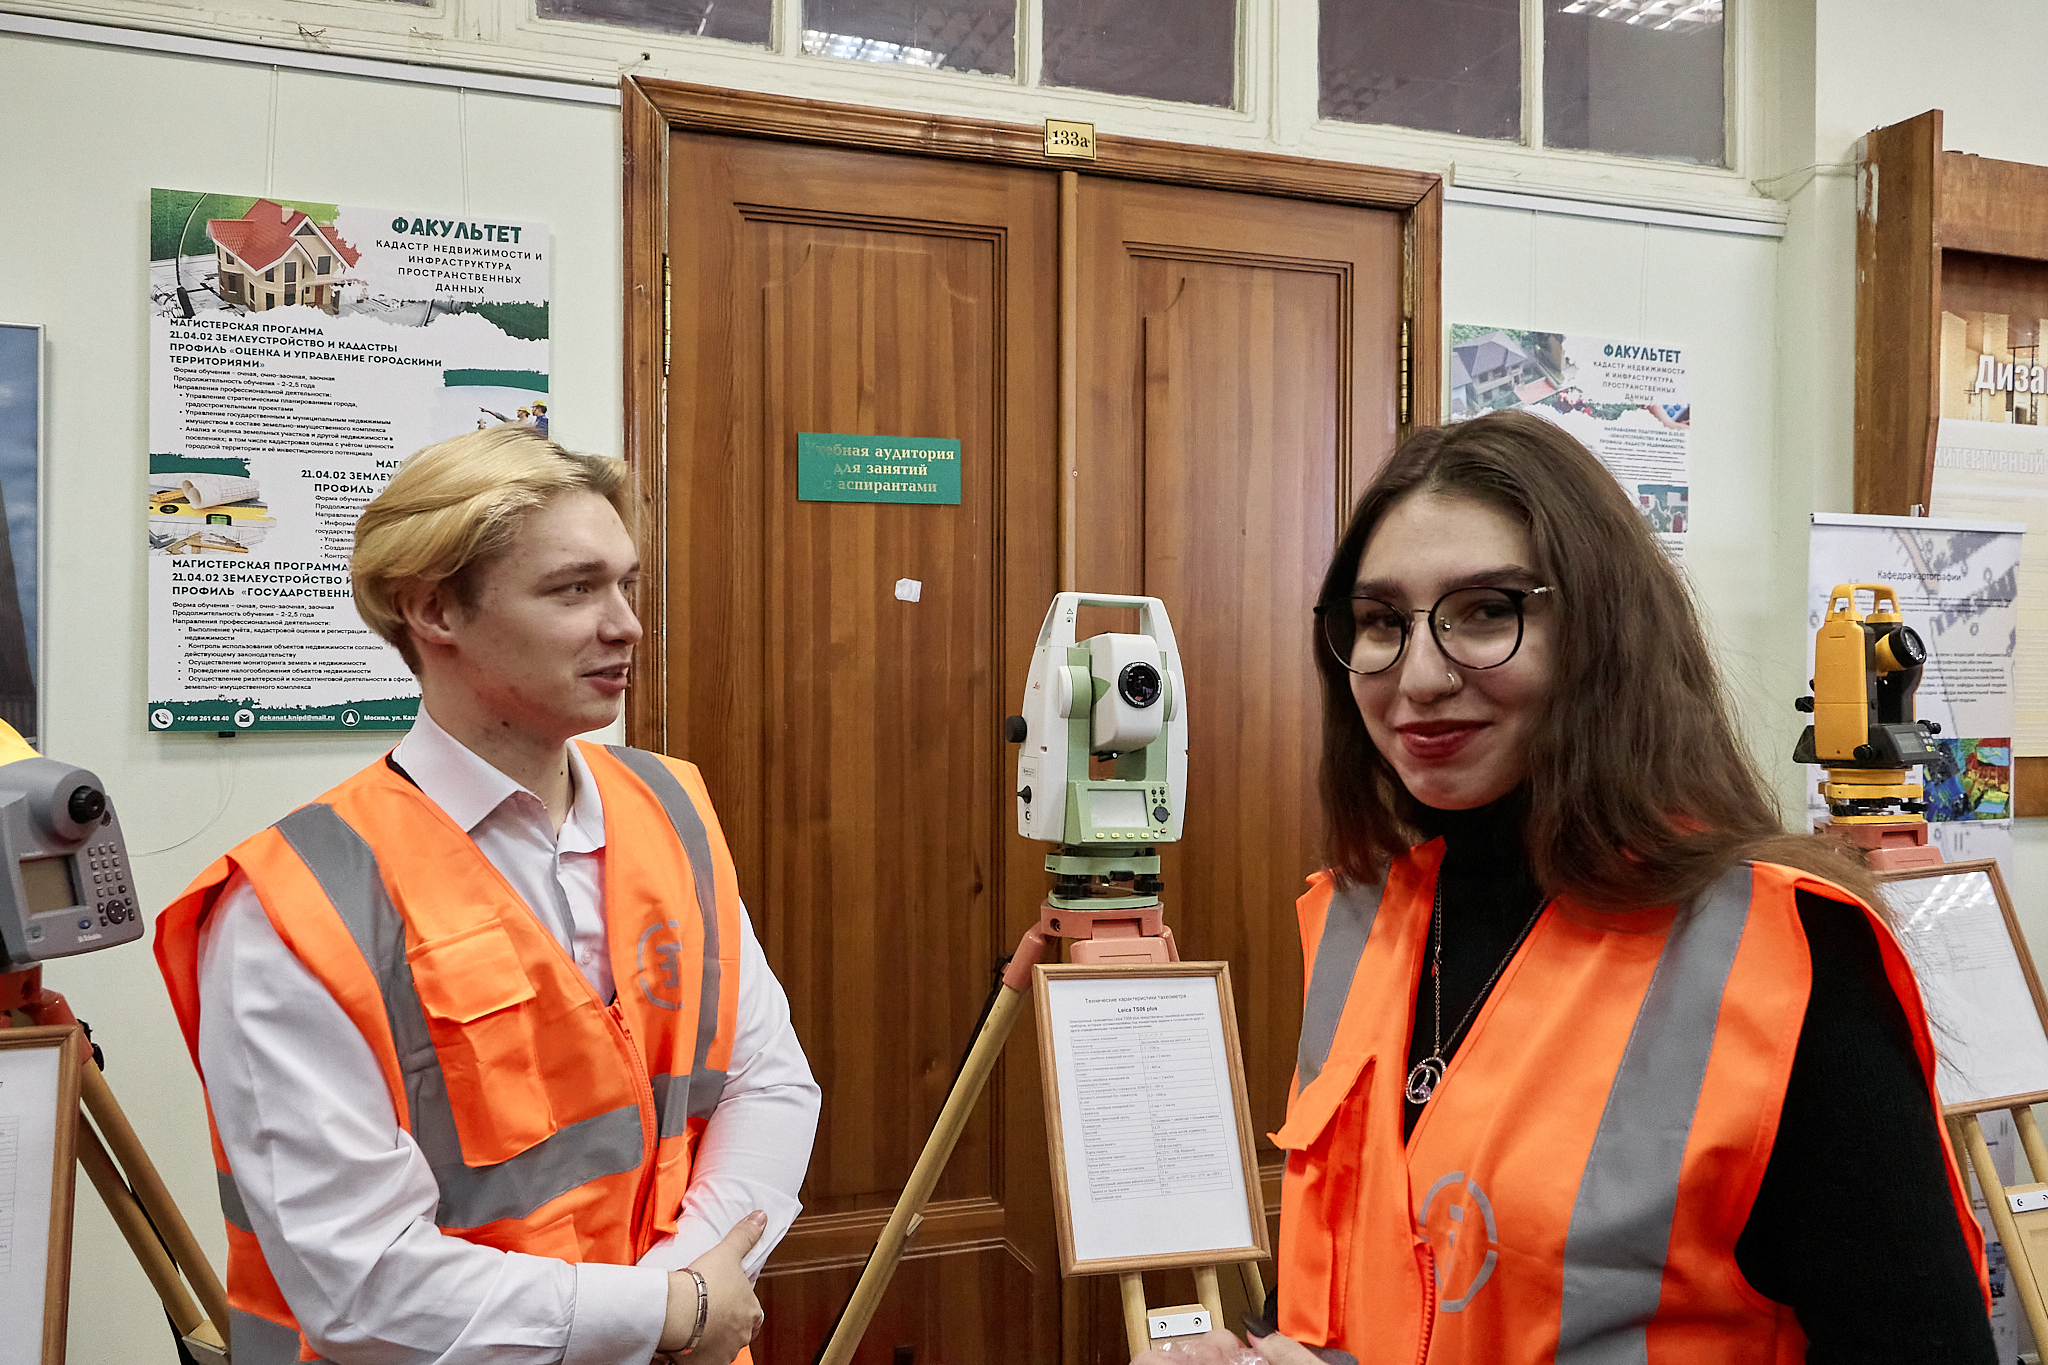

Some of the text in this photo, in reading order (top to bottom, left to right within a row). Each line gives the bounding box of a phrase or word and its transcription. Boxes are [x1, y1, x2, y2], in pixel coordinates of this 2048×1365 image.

[392, 217, 522, 243] ФАКУЛЬТЕТ
[376, 240, 429, 251] КАДАСТР
[433, 245, 531, 259] НЕДВИЖИМОСТИ
[408, 256, 512, 270] ИНФРАСТРУКТУРА
[398, 268, 521, 284] ПРОСТРАНСТВЕННЫХ
[436, 283, 484, 294] ДАННЫХ
[170, 319, 324, 335] МАГИСТЕРСКАЯ ПРОГАММА
[170, 331, 398, 352] 21.04.02 ЗЕМЛЕУСТРОЙСТВО И КАДАСТРЫ
[170, 343, 442, 367] ПРОФИЛЬ «ОЦЕНКА И УПРАВЛЕНИЕ ГОРОДСКИМИ
[1604, 344, 1681, 363] ФАКУЛЬТЕТ
[170, 355, 265, 367] ТЕРРИТОРИЯМИ»
[1627, 365, 1686, 375] НЕДВИЖИМОСТИ
[1975, 355, 2048, 395] Диза
[173, 375, 242, 384] Продолжительность
[1612, 373, 1674, 383] ИНФРАСТРУКТУРА
[1602, 381, 1676, 393] ПРОСТРАНСТВЕННЫХ
[262, 423, 351, 431] земельно-имущественного
[875, 448, 954, 461] аудитория
[301, 470, 346, 479] 21.04.02
[834, 464, 927, 475] для занятий
[314, 484, 373, 493] ПРОФИЛЬ
[838, 481, 937, 493] аспирантами
[172, 560, 348, 571] МАГИСТЕРСКАЯ ПРОГРАММА
[172, 573, 219, 582] 21.04.02
[222, 574, 342, 584] ЗЕМЛЕУСТРОЙСТВО
[1878, 570, 1961, 581] Кафедра картографии
[172, 586, 353, 598] ПРОФИЛЬ «ГОСУДАРСТВЕНН
